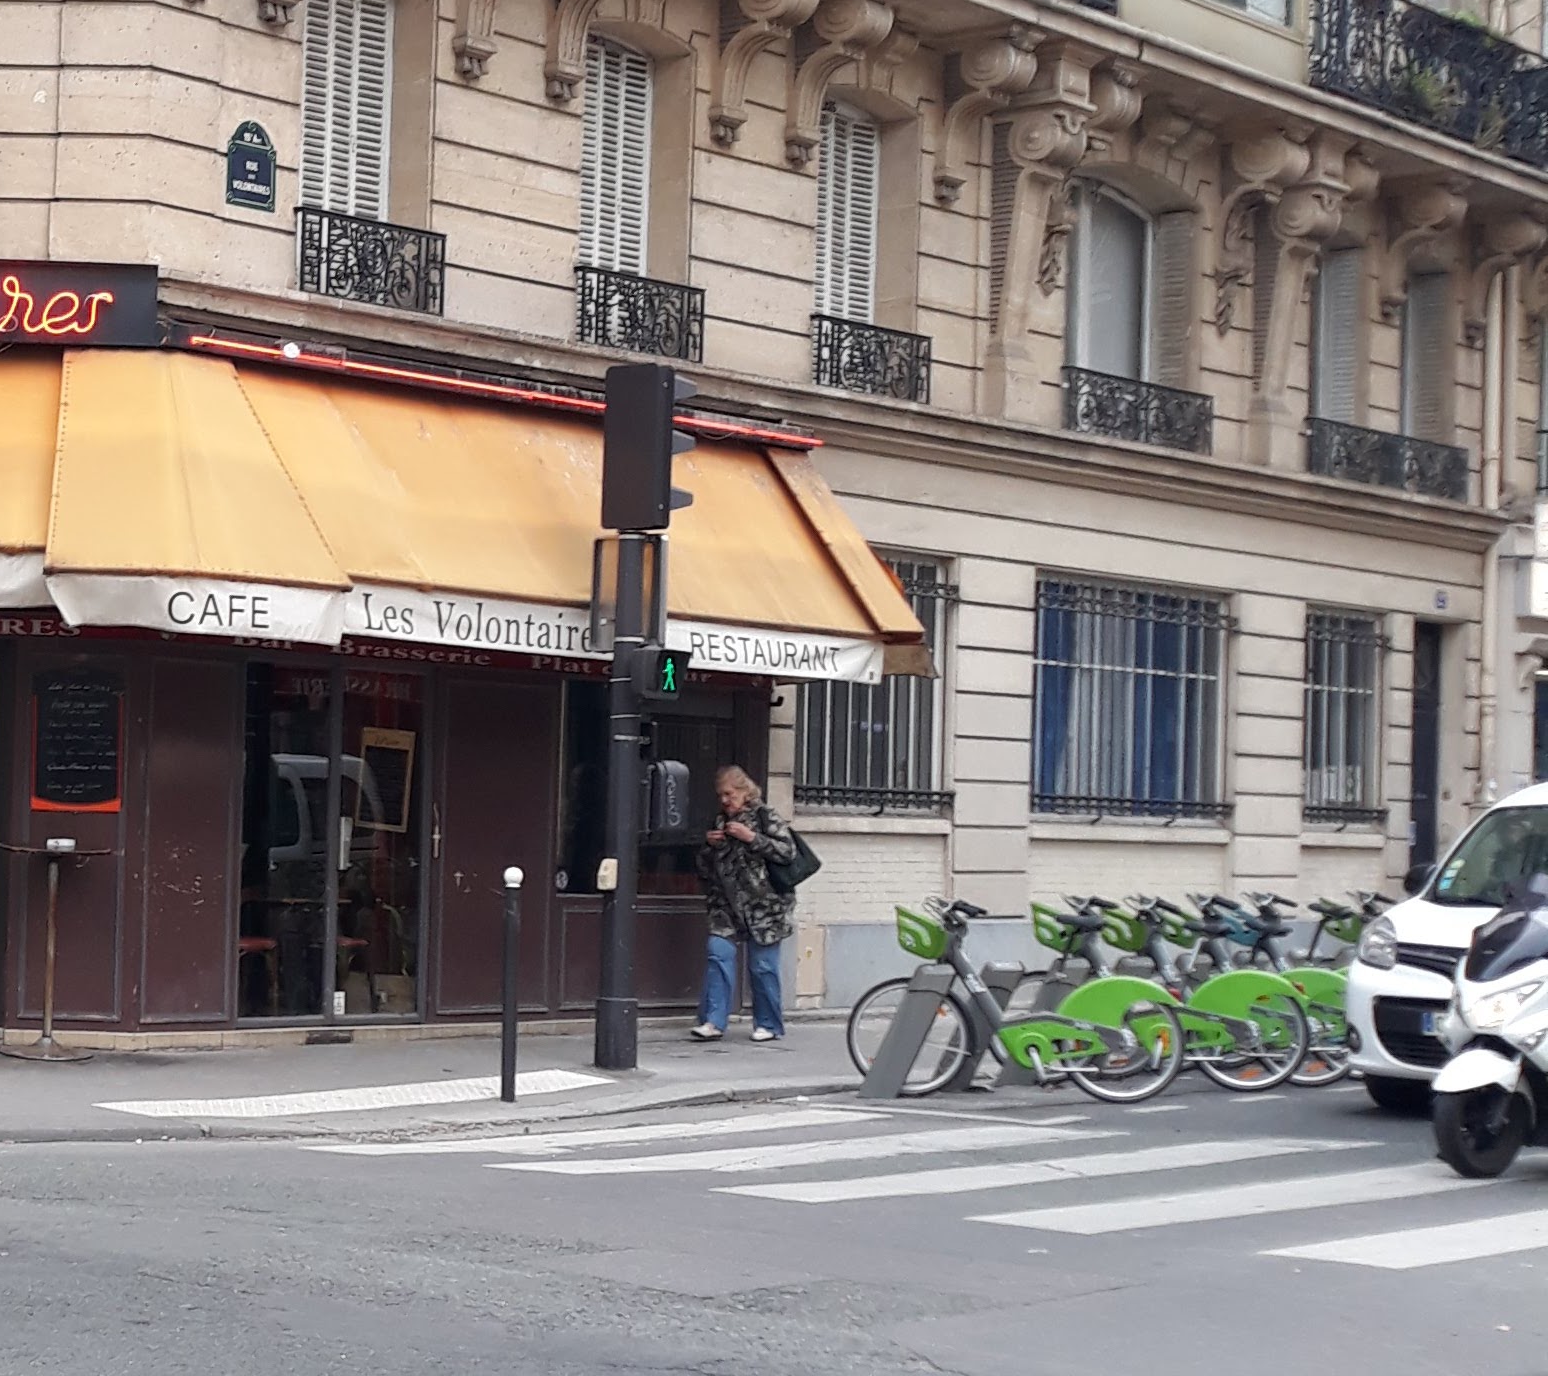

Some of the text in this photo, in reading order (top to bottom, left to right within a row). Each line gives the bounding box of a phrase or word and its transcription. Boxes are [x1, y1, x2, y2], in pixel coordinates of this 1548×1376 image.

[166, 590, 271, 629] CAFE
[362, 592, 592, 654] Les Volontaire
[330, 639, 493, 666] Brasserie
[532, 653, 593, 674] Plat
[690, 631, 842, 674] RESTAURANT
